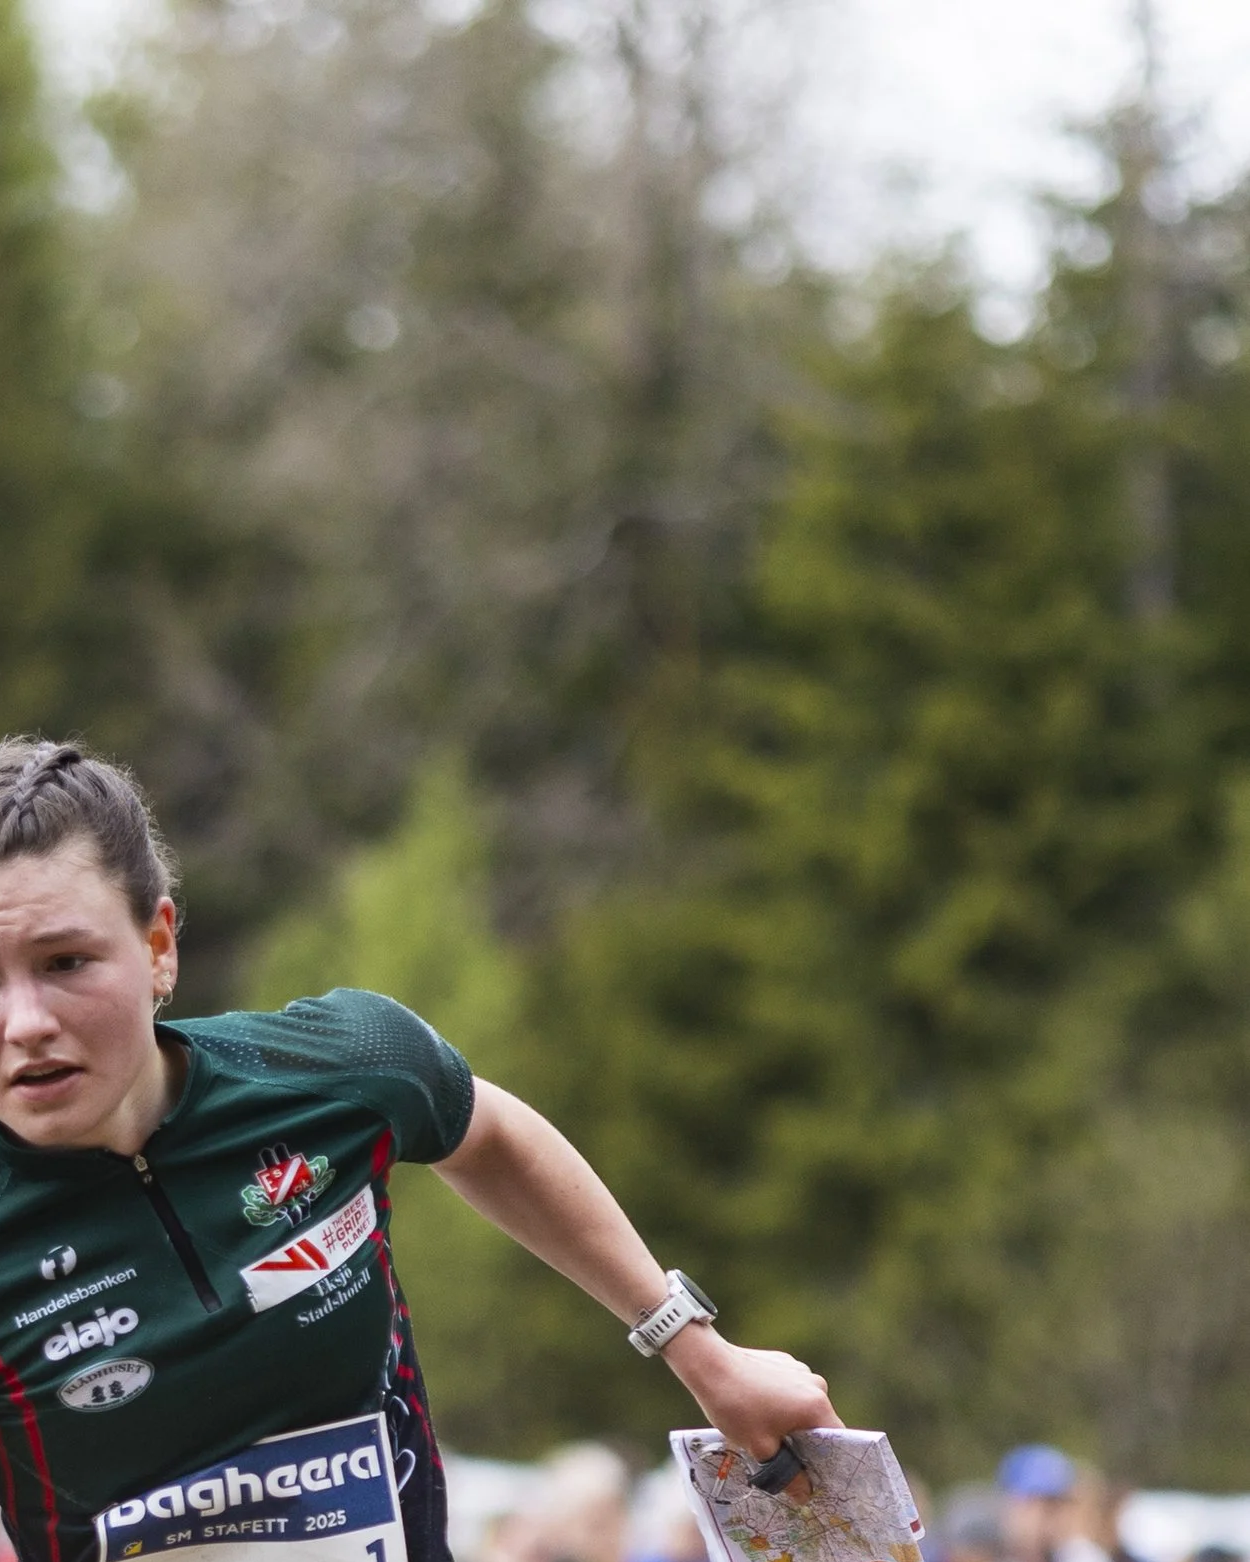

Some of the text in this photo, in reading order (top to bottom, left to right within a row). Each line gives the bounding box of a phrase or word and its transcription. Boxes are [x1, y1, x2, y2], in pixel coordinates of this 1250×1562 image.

[342, 1216, 371, 1252] PLANET
[14, 1267, 138, 1329] Handelsbanken
[296, 1266, 372, 1328] Stadshotell
[315, 1263, 354, 1298] Eksjö
[44, 1307, 140, 1361] elajo
[166, 1510, 348, 1546] SM STAFETT 2025
